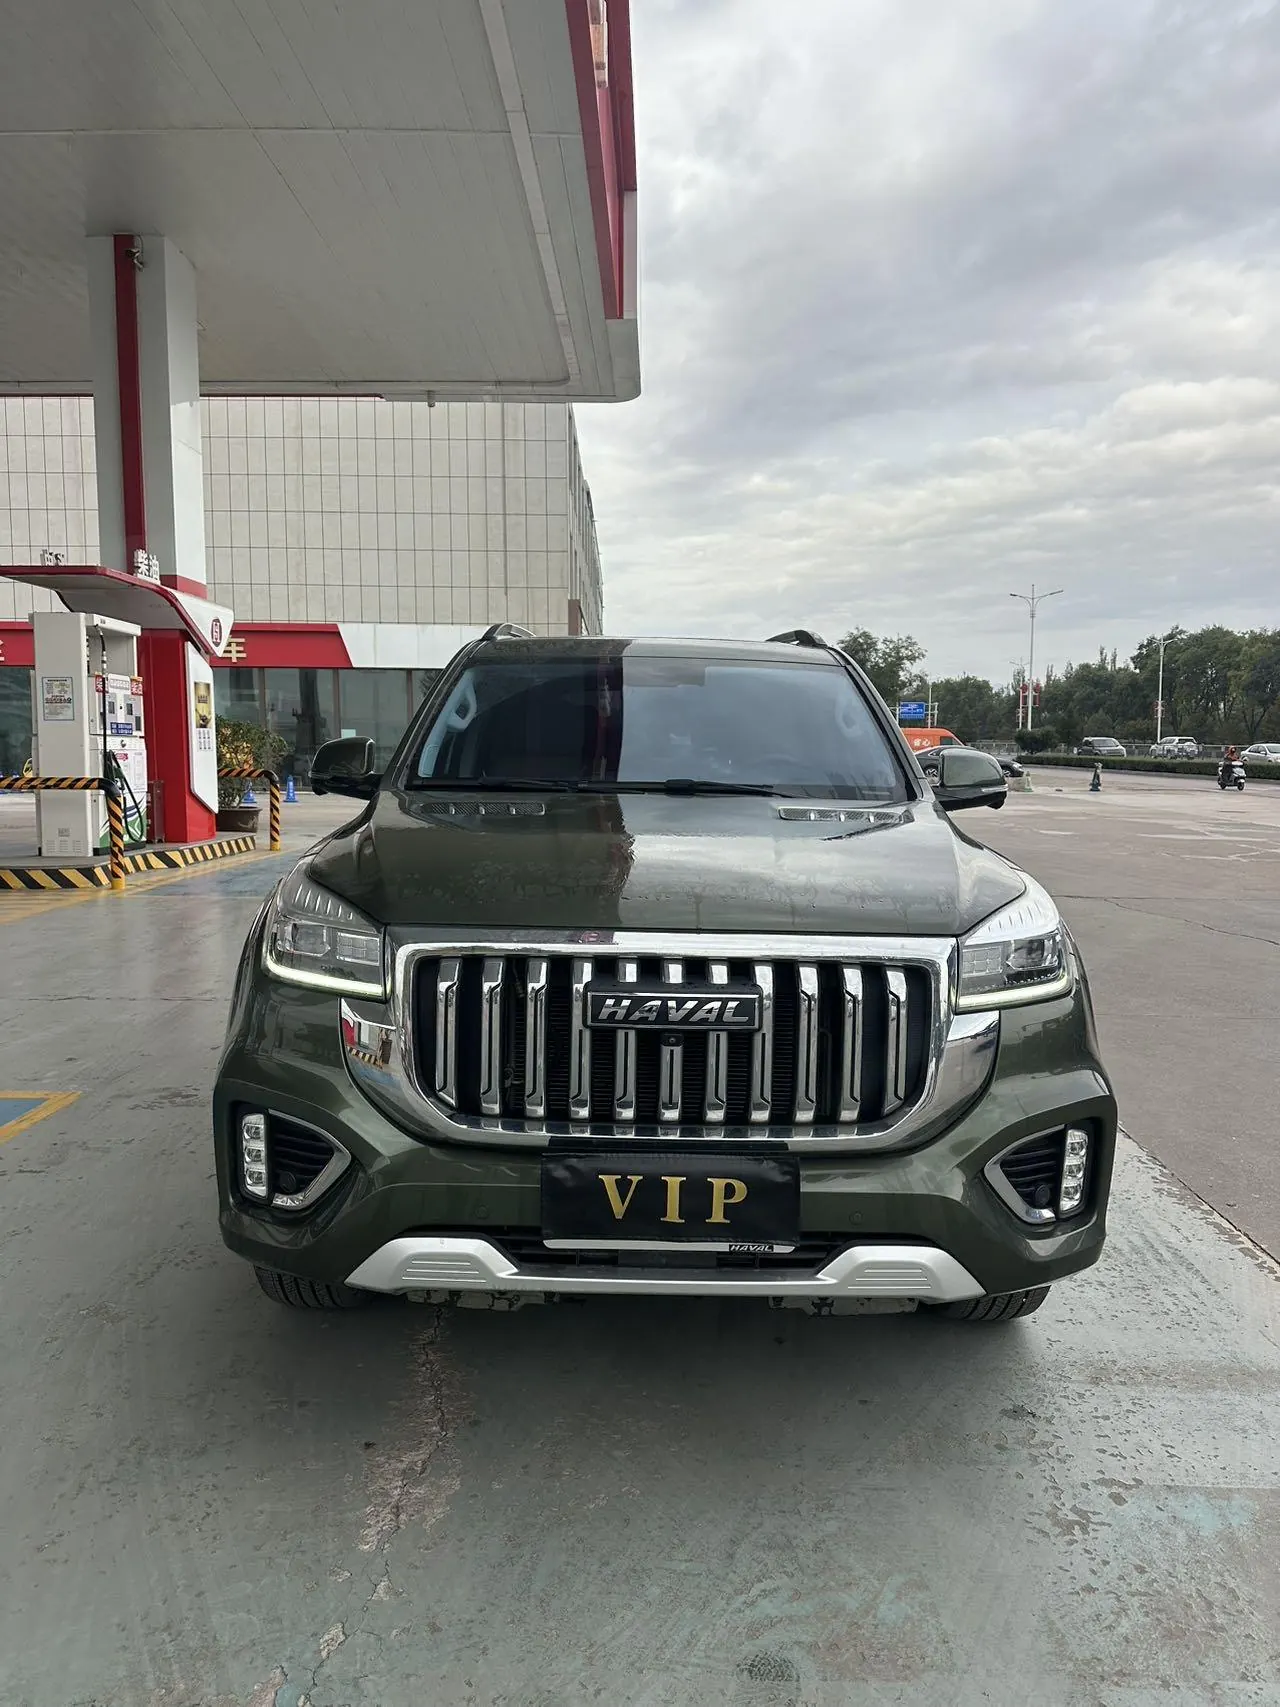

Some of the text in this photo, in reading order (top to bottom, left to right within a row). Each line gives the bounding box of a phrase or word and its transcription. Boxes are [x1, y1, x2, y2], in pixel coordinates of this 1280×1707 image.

[133, 549, 160, 585] 柴油
[598, 998, 749, 1023] HAVAL
[598, 1174, 749, 1224] VIP
[730, 1244, 773, 1252] HAVAL
